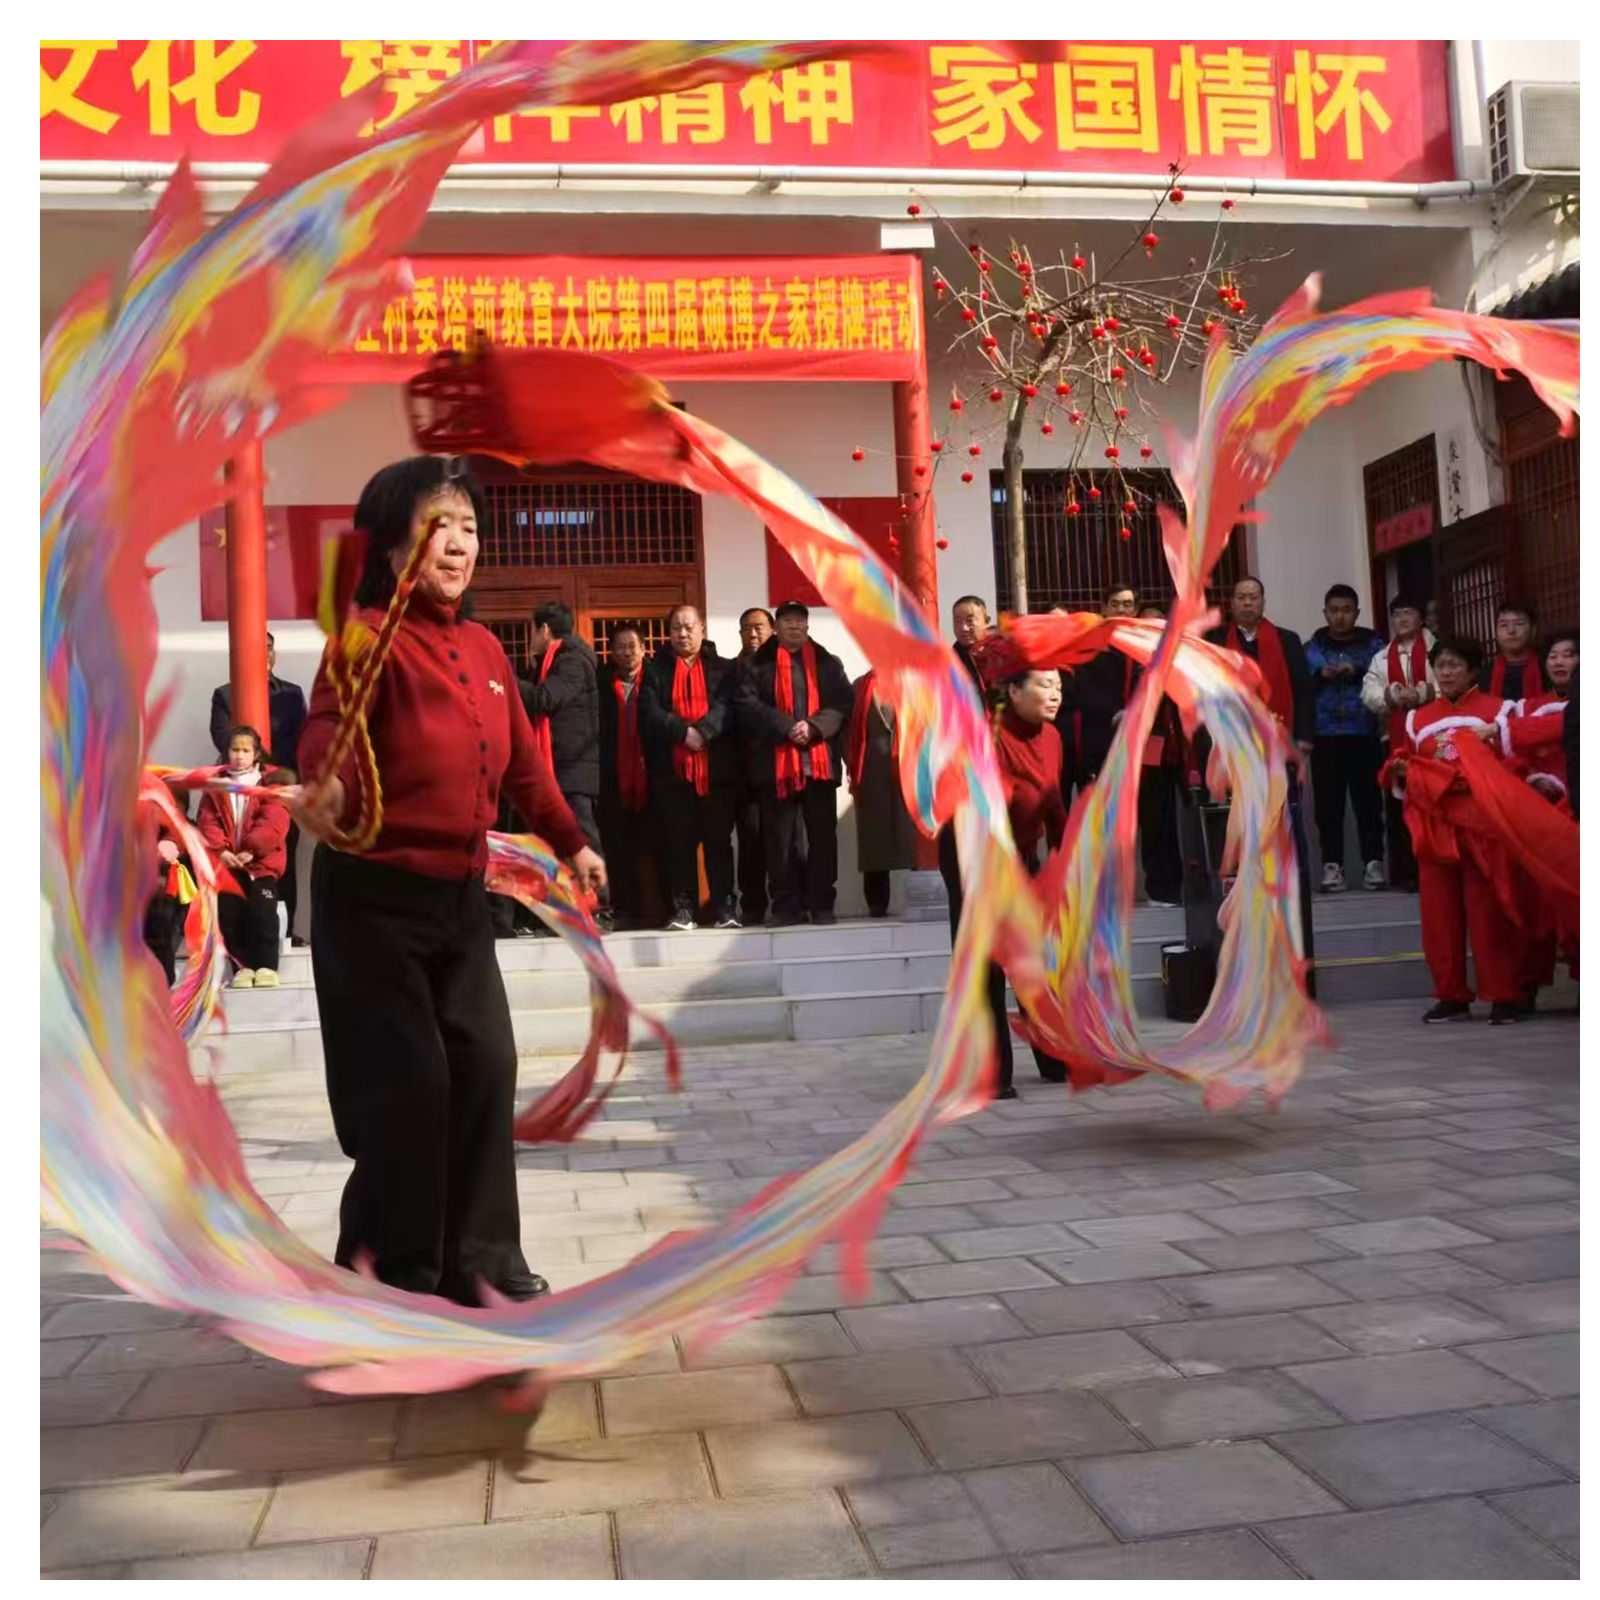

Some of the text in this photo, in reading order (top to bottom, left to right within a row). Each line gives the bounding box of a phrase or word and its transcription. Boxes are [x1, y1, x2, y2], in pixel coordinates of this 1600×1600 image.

[40, 41, 1392, 161] 文化 榜神 家国情怀
